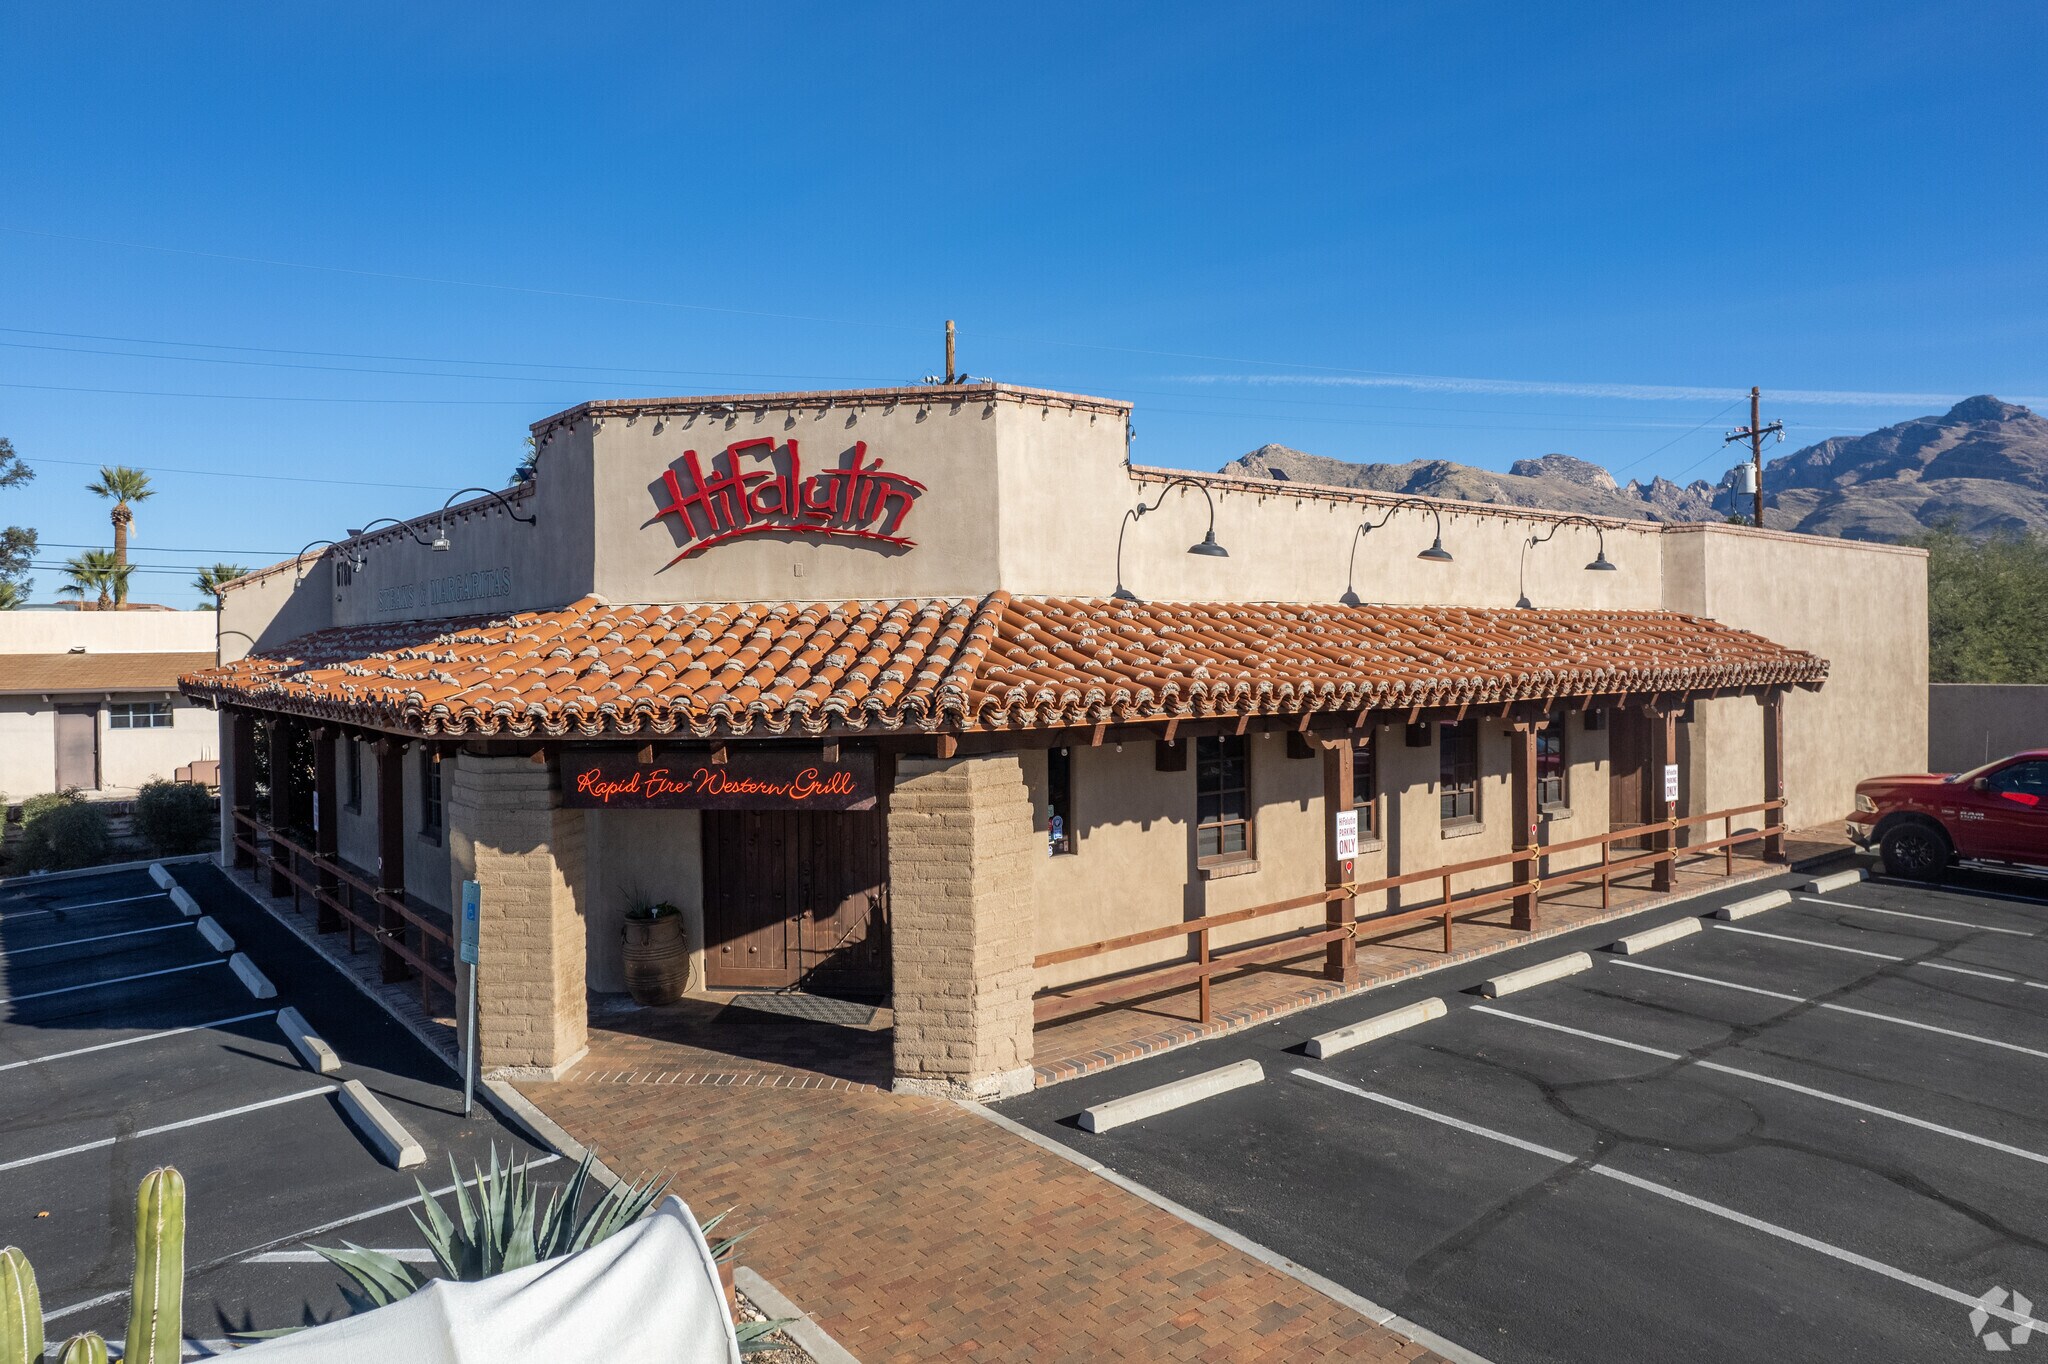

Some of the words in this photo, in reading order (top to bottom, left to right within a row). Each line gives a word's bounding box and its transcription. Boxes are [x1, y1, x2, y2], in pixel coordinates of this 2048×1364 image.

[379, 584, 415, 612] STEAKS
[431, 566, 512, 605] MARGARITAS
[577, 768, 641, 802] Rapid
[644, 768, 690, 799] Fire
[693, 768, 789, 796] Western
[789, 767, 855, 800] Grill
[1339, 827, 1356, 837] PARKING
[1339, 838, 1356, 855] ONLY
